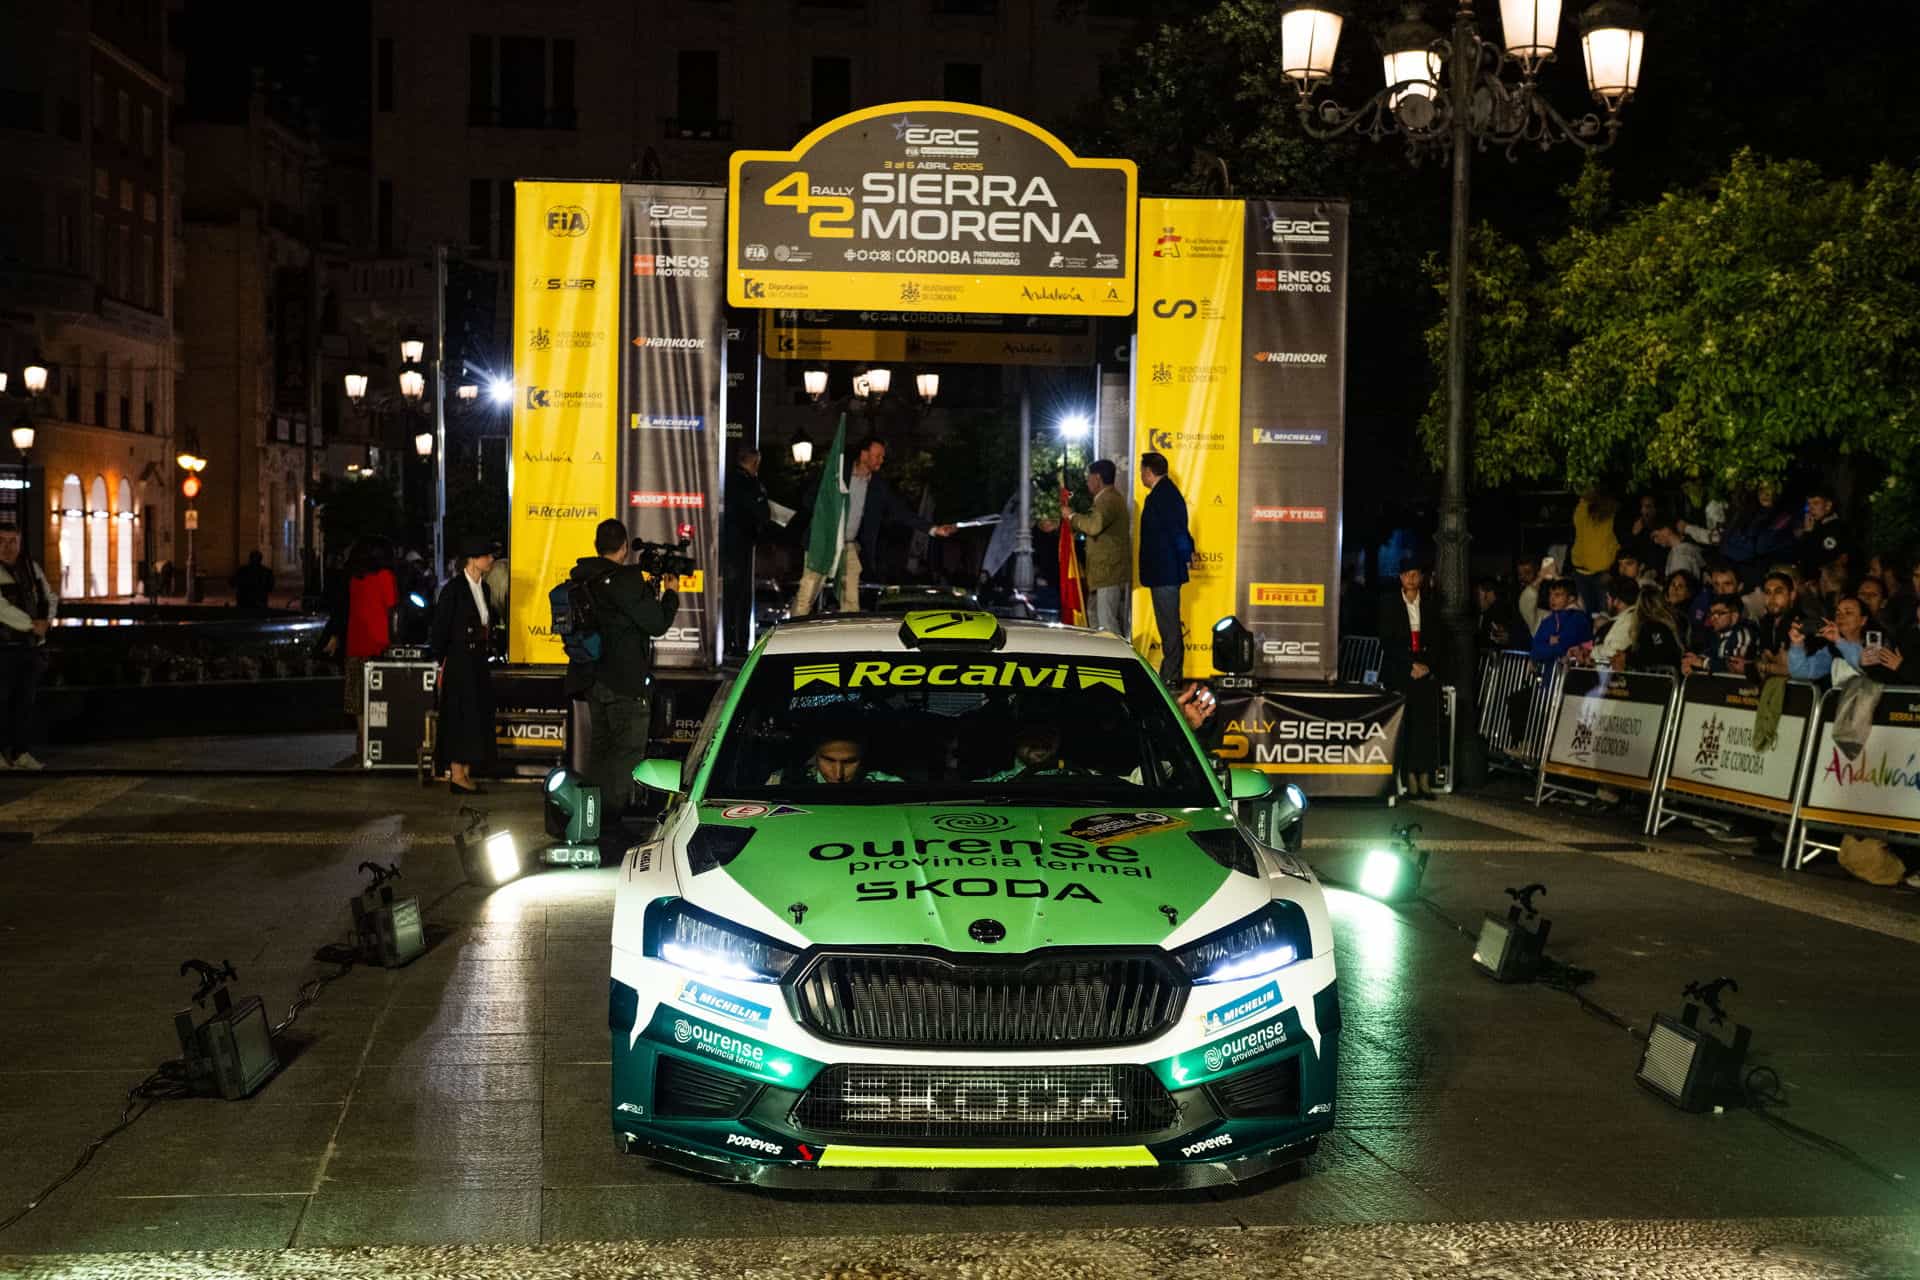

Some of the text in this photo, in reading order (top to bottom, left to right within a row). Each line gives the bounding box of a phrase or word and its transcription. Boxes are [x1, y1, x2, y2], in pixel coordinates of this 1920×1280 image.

[917, 161, 951, 170] ABRIL
[952, 162, 983, 171] 2025
[811, 186, 855, 197] RALLY
[862, 173, 1058, 207] SIERRA
[764, 171, 855, 238] 42
[547, 212, 585, 231] FIA
[862, 208, 1101, 244] MORENA
[656, 255, 709, 268] ENEOS
[745, 247, 767, 258] FIA
[895, 248, 970, 265] CÓRDOBA
[656, 268, 709, 278] MOTOR OIL
[1278, 270, 1331, 283] ENEOS
[1279, 284, 1331, 293] MOTOR OIL
[652, 418, 700, 427] MICHELIN
[540, 505, 586, 518] Recalvi
[1256, 587, 1318, 602] PIRELLI
[848, 661, 1069, 689] Recalvi
[1225, 719, 1388, 740] ALLY SIERRA
[1256, 743, 1388, 763] MORENA
[809, 839, 1140, 863] ourense
[849, 855, 1152, 880] provincia termal
[699, 992, 762, 1020] MICHELIN
[1223, 989, 1275, 1021] MICHELIN
[692, 1025, 764, 1061] ourense
[1222, 1021, 1284, 1057] ourense
[697, 1041, 763, 1071] provincia termal
[1231, 1034, 1287, 1065] provincia termal
